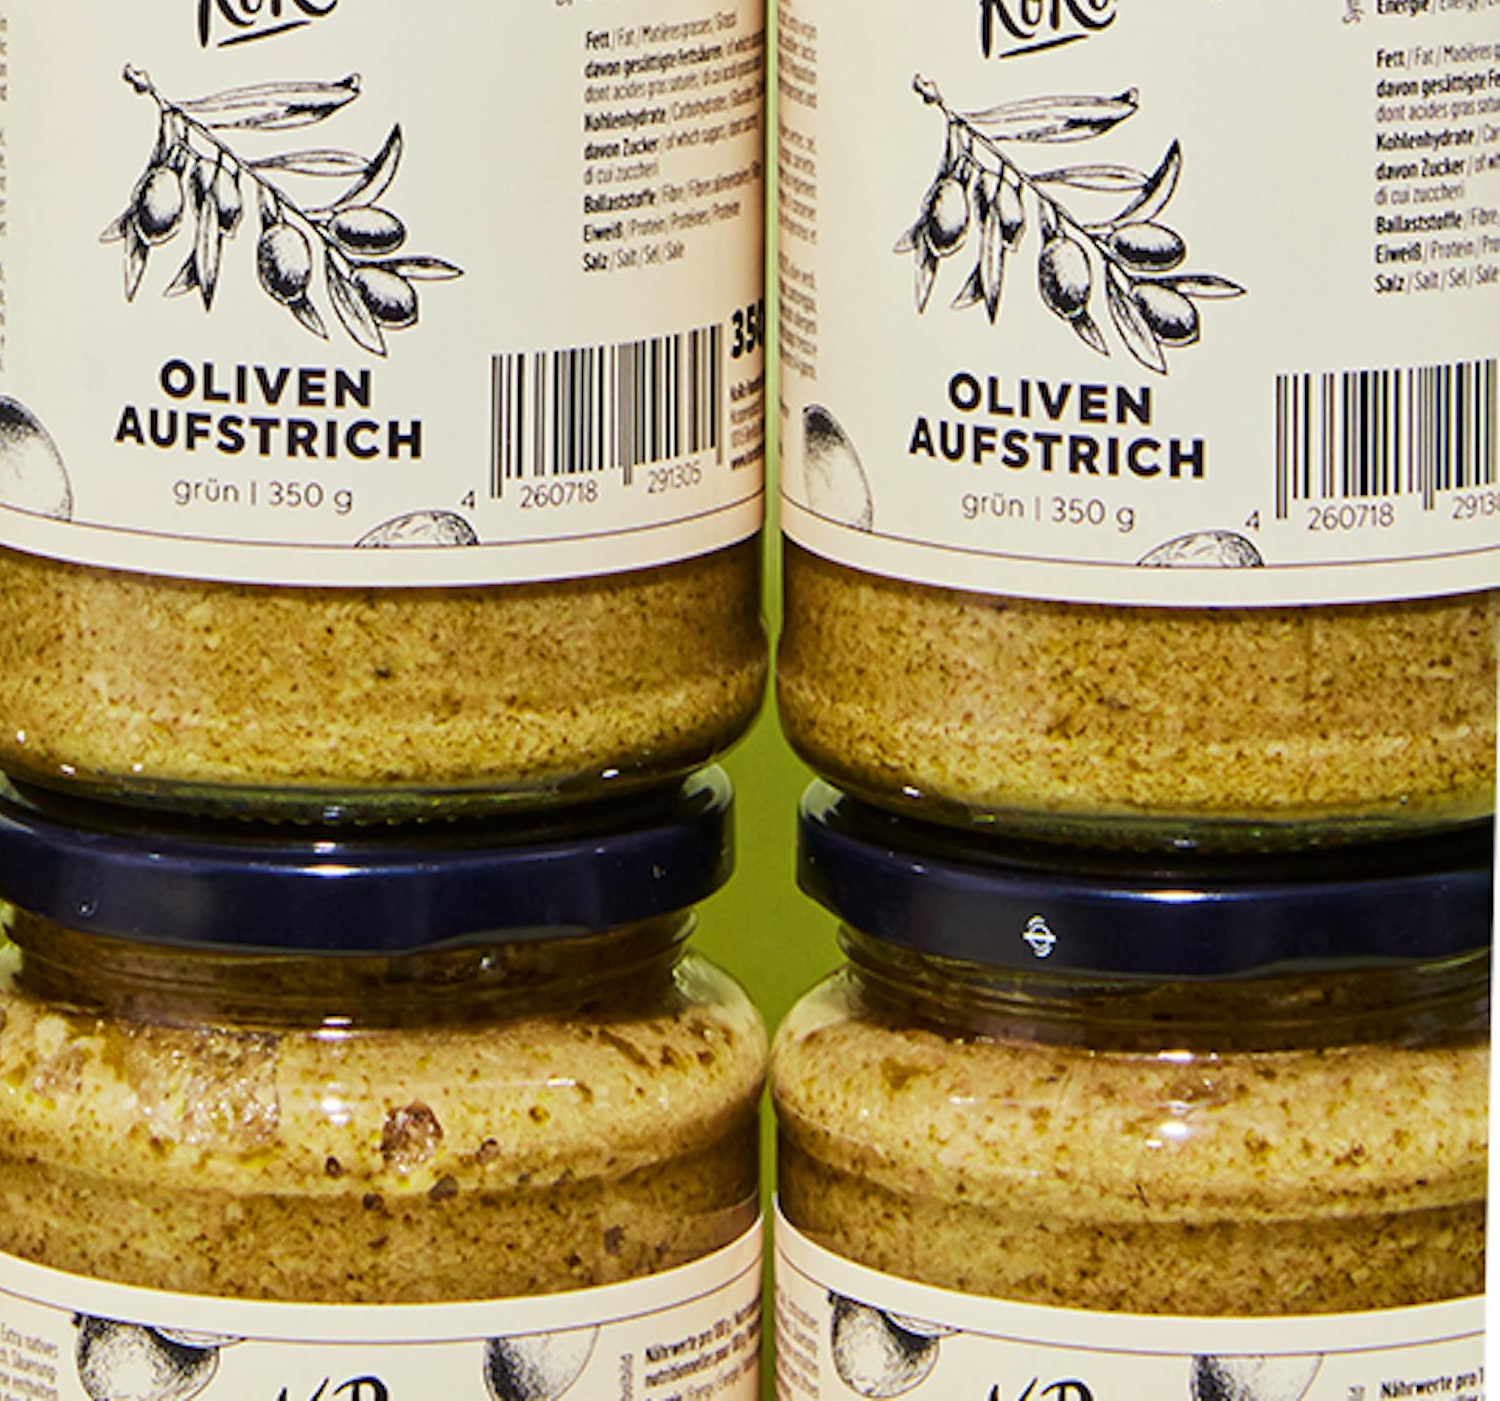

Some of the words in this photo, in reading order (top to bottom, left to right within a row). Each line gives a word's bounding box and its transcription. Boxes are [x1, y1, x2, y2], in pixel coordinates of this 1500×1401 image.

[585, 31, 609, 50] Fett
[1377, 48, 1404, 68] Fett
[1376, 129, 1474, 151] Kohlenhydrate
[1421, 157, 1465, 177] Zucker
[1374, 273, 1405, 295] Salz
[160, 358, 371, 409] OLIVEN
[948, 371, 1152, 426] OLIVEN
[115, 405, 422, 460] AUFSTRICH
[909, 415, 1205, 478] AUFSTRICH
[172, 477, 240, 506] grün
[269, 481, 323, 508] 350
[334, 489, 353, 515] g
[461, 490, 476, 510] 4
[520, 479, 598, 509] 260718
[648, 461, 702, 494] 291305
[961, 492, 1025, 519] grün
[1051, 496, 1106, 525] 350
[1116, 506, 1136, 533] g
[1245, 510, 1260, 531] 4
[1307, 502, 1394, 531] 260718
[1452, 491, 1500, 520] 2913
[1381, 1376, 1453, 1398] Nährwerte
[1456, 1371, 1476, 1391] pro
